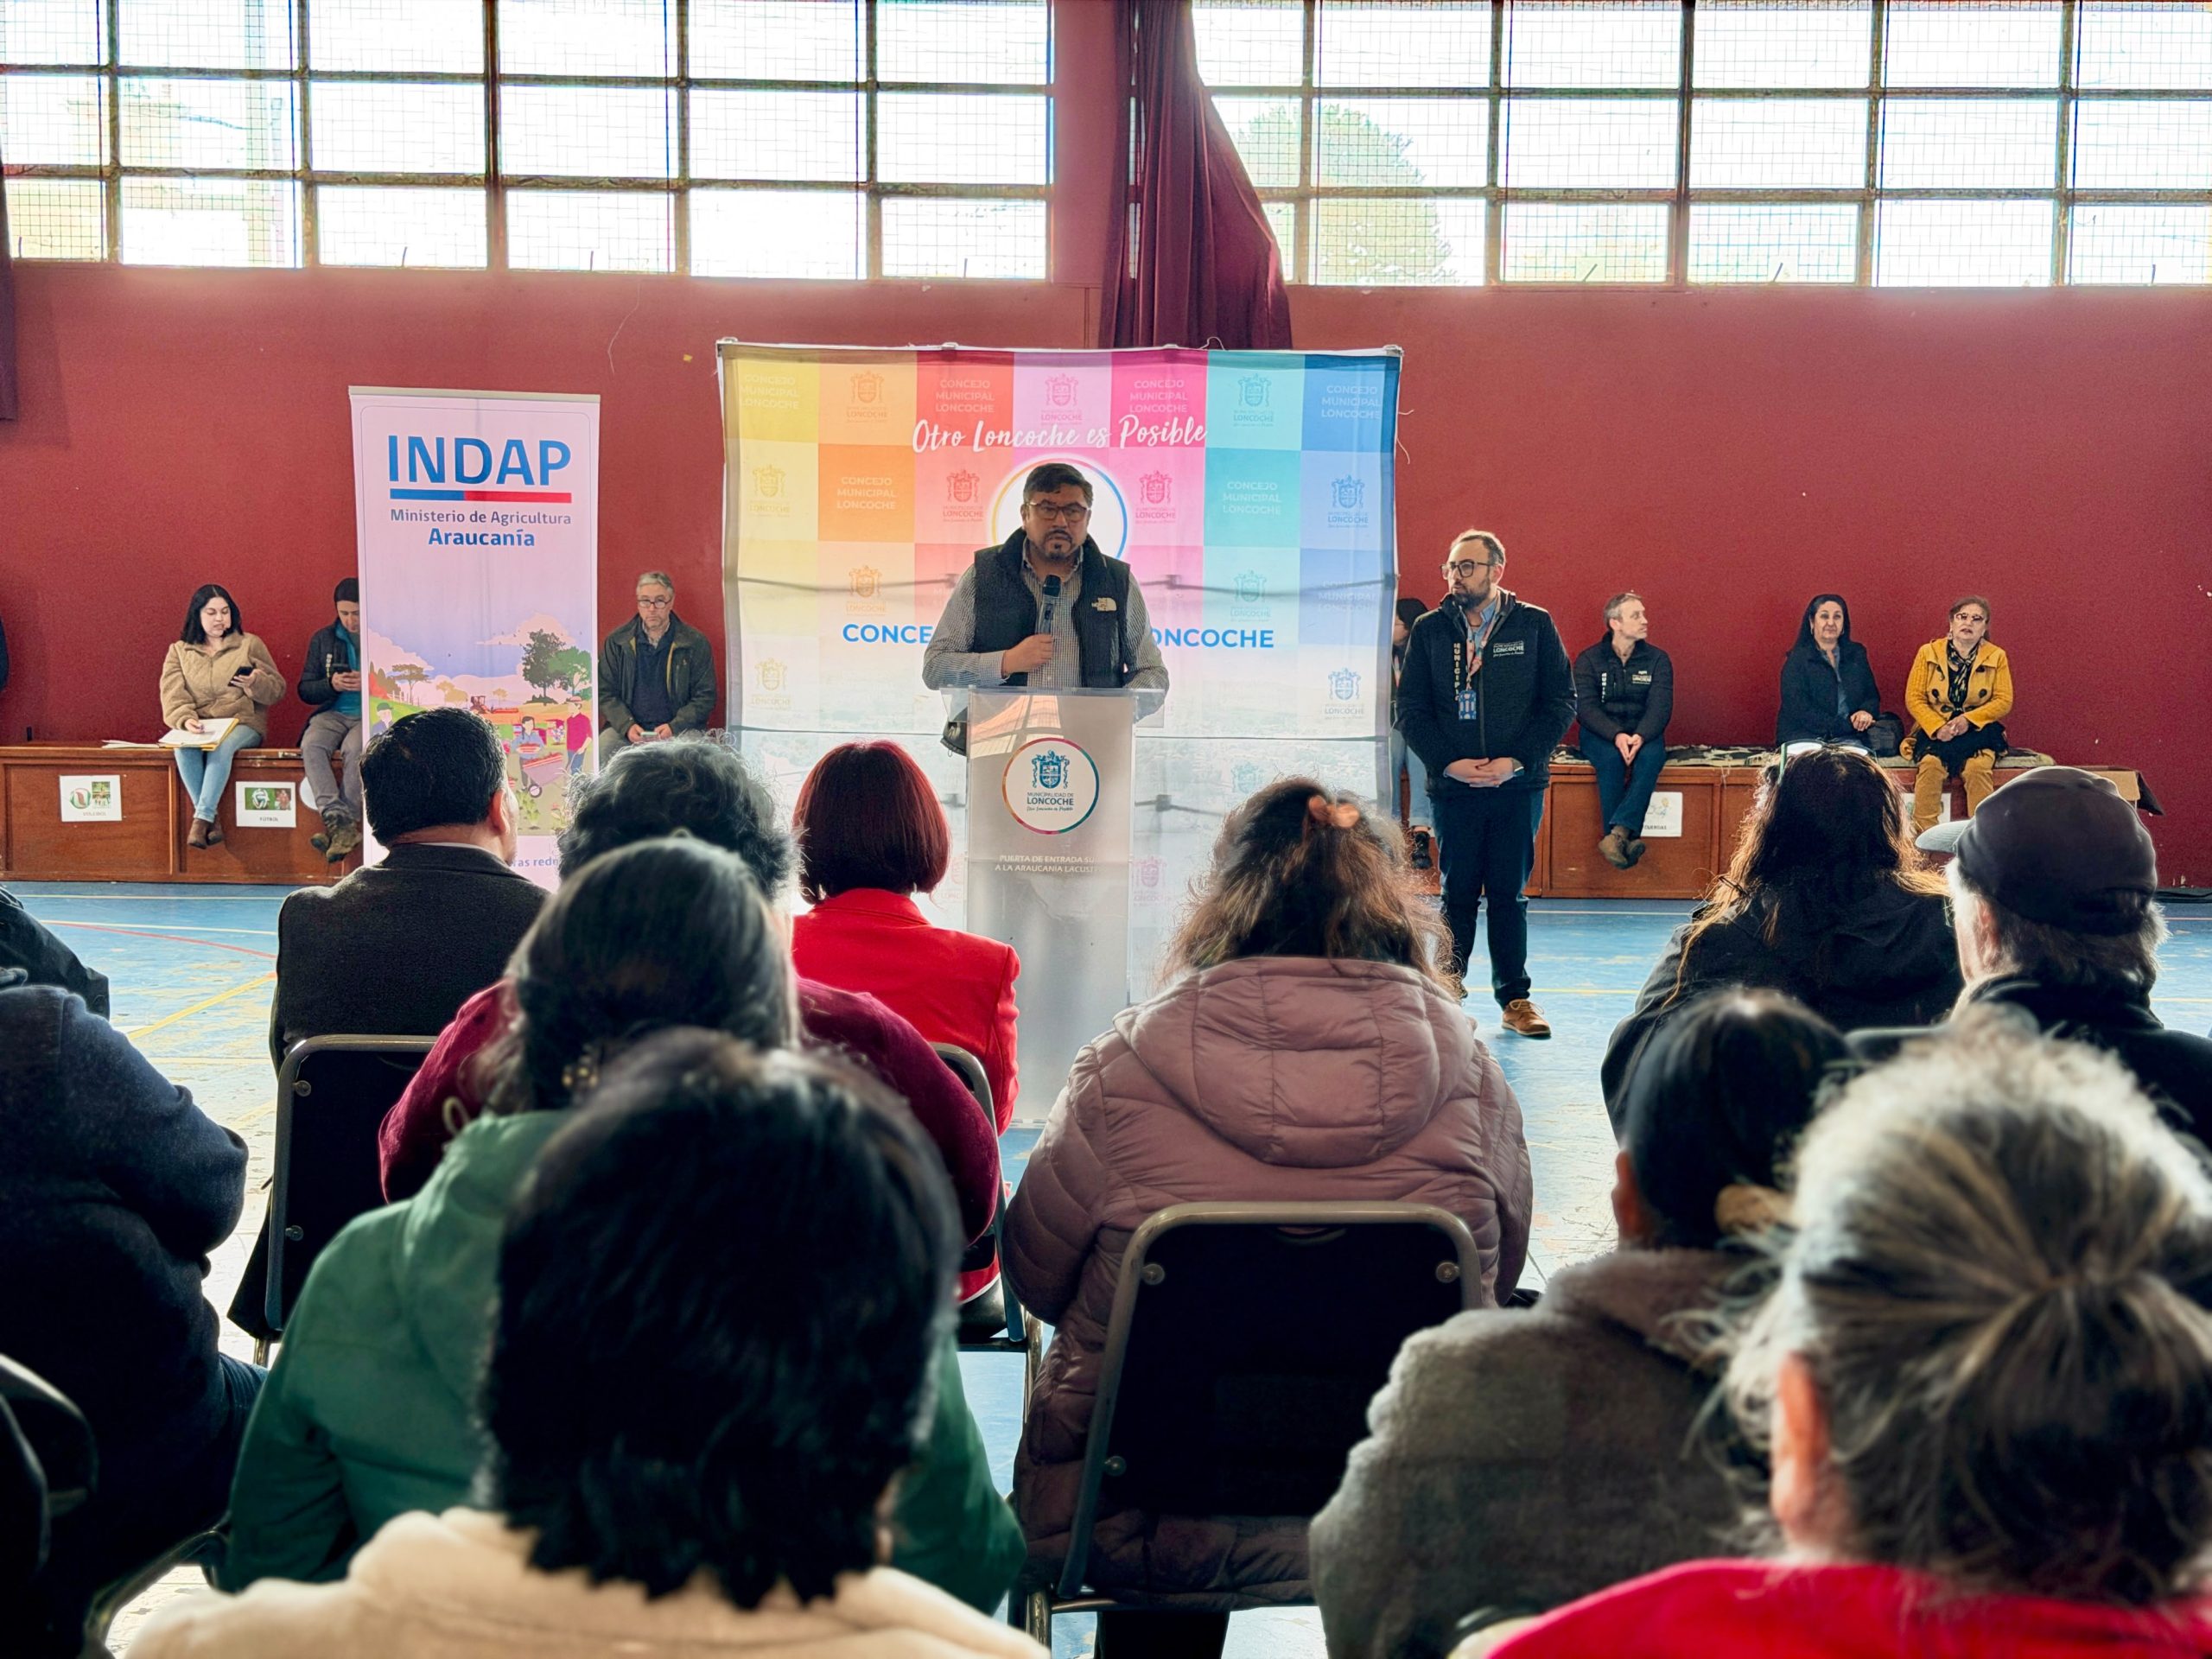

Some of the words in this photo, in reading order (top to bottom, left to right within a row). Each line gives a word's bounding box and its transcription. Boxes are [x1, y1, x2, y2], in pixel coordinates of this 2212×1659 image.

[940, 379, 990, 388] CONCEJO
[1134, 380, 1184, 389] CONCEJO
[1326, 385, 1377, 395] CONCEJO
[936, 391, 995, 401] MUNICIPAL
[1129, 391, 1187, 401] MUNICIPAL
[1321, 397, 1382, 407] MUNICIPAL
[935, 404, 994, 413] LONCOCHE
[1129, 404, 1187, 413] LONCOCHE
[1321, 410, 1381, 419] LONCOCHE
[912, 419, 965, 453] Otro
[973, 420, 1079, 452] Loncoche
[1087, 426, 1113, 447] es
[1118, 414, 1207, 449] Posible
[388, 435, 571, 486] INDAP
[841, 476, 893, 486] CONCEJO
[1227, 481, 1278, 491] CONCEJO
[836, 487, 898, 499] MUNICIPAL
[1223, 493, 1281, 503] MUNICIPAL
[836, 500, 897, 511] LONCOCHE
[1223, 505, 1281, 516] LONCOCHE
[390, 508, 465, 522] Ministerio
[469, 510, 486, 523] de
[490, 511, 571, 526] Agricultura
[428, 528, 535, 546] Araucanía
[842, 623, 933, 645] CONCE
[1152, 627, 1274, 649] ONCOCHE
[1027, 797, 1074, 805] LONCOCHE
